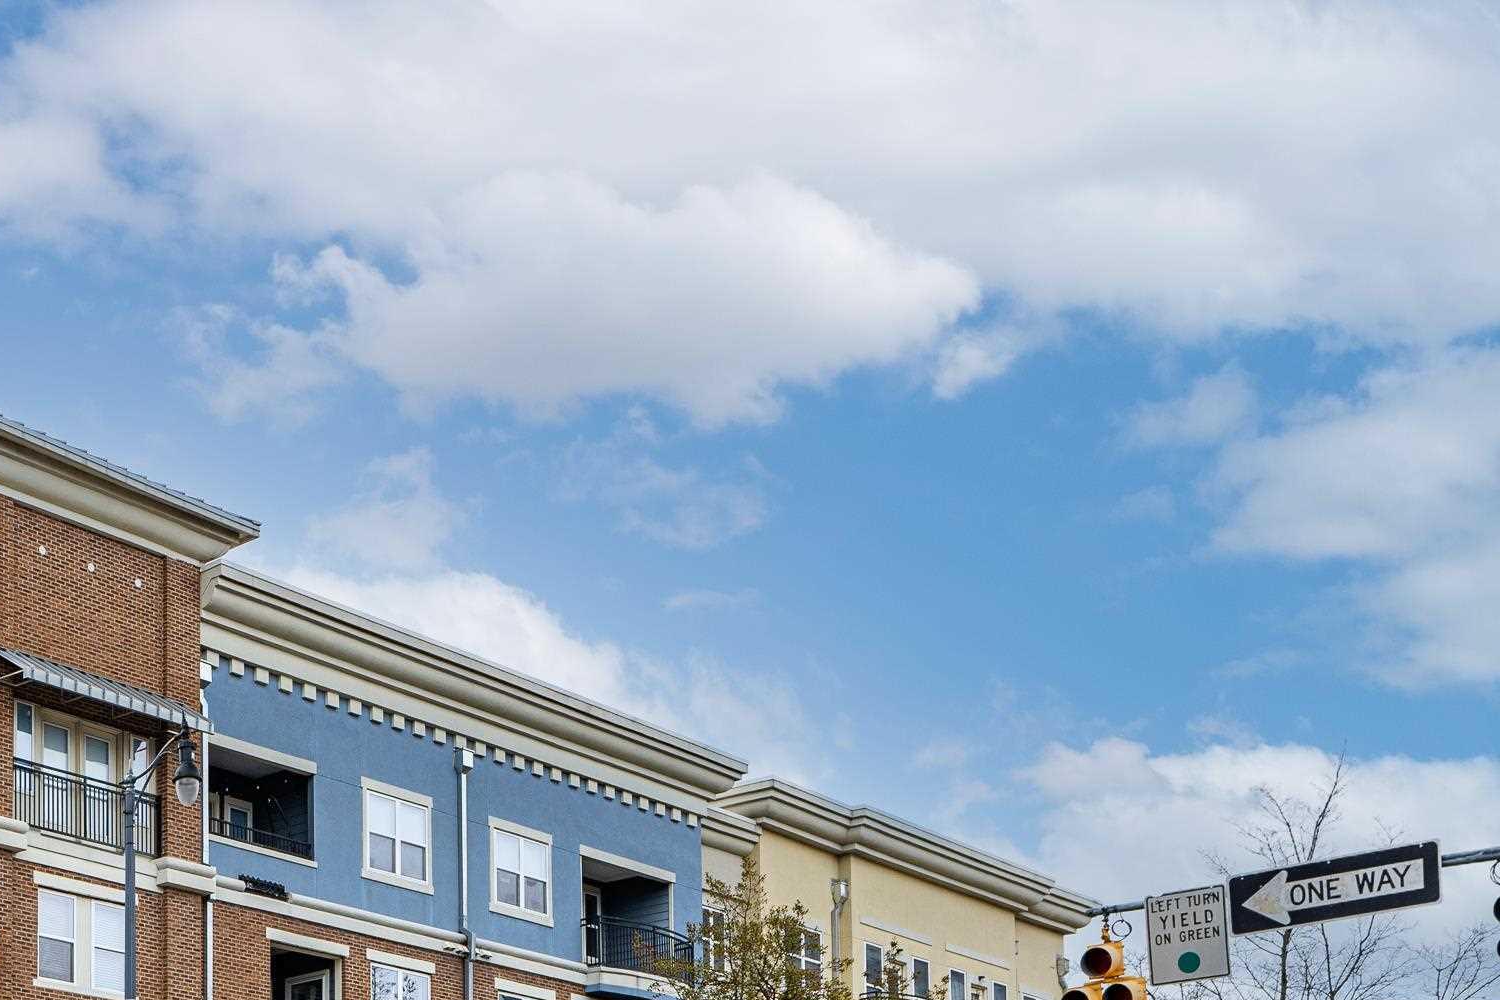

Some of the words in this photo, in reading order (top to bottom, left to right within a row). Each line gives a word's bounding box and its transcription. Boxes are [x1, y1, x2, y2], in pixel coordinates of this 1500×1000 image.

[1289, 877, 1342, 906] ONE
[1355, 864, 1412, 895] WAY
[1151, 898, 1180, 913] LEFT
[1187, 891, 1220, 908] TURN
[1160, 909, 1214, 930] YIELD
[1155, 933, 1171, 946] ON
[1179, 926, 1220, 942] GREEN
